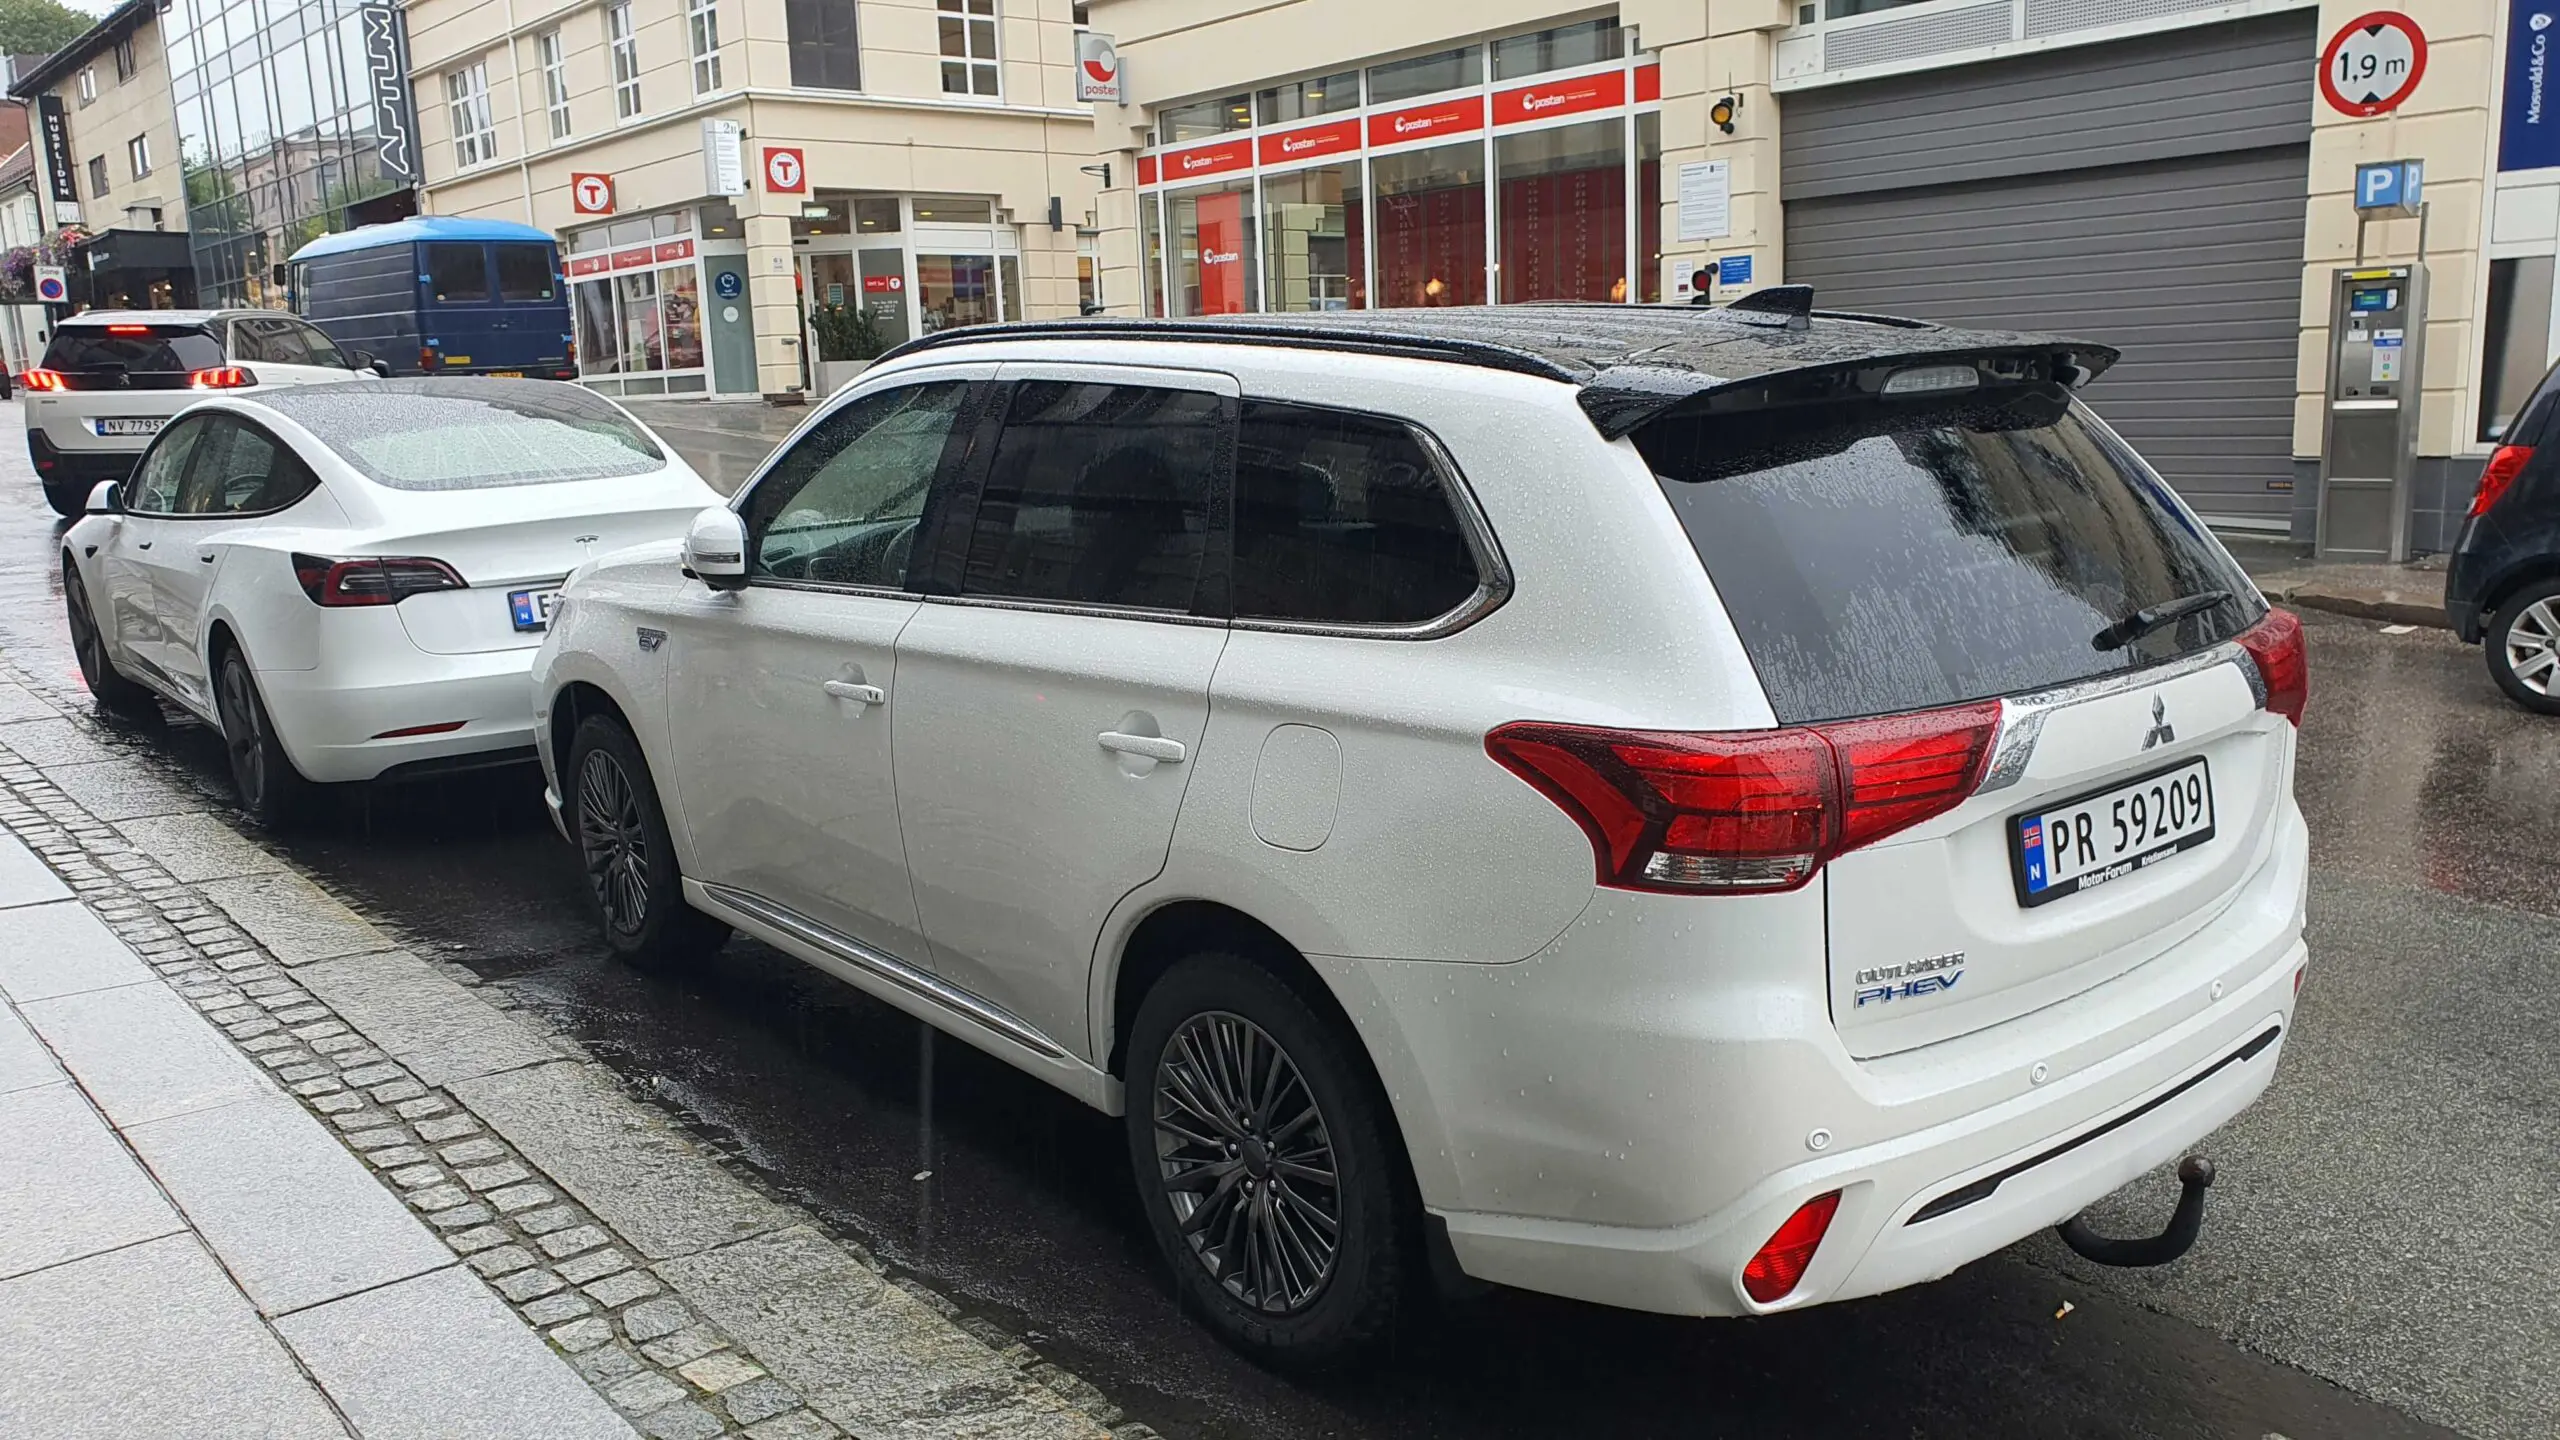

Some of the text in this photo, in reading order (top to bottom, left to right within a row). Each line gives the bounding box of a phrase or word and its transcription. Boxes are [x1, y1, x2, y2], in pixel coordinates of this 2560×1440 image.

[2340, 52, 2405, 84] 1,9 m
[2526, 34, 2546, 124] Mosvold&Co
[364, 8, 409, 174] APTUM
[1085, 84, 1119, 96] posten
[1534, 94, 1566, 110] posten
[1405, 117, 1432, 132] posten
[1292, 138, 1316, 152] posten
[777, 161, 792, 181] T
[1190, 156, 1213, 170] posten
[2366, 168, 2393, 203] P
[2407, 166, 2420, 200] P
[584, 185, 601, 205] T
[1213, 251, 1239, 264] posten
[108, 421, 124, 432] NV
[537, 593, 566, 618] E
[521, 612, 529, 620] N
[2052, 773, 2202, 875] PR 59209
[2030, 862, 2042, 881] N
[2078, 860, 2133, 890] MotorForum
[1855, 949, 1965, 985] OUTLANDER
[1853, 967, 1966, 1010] PHEV
